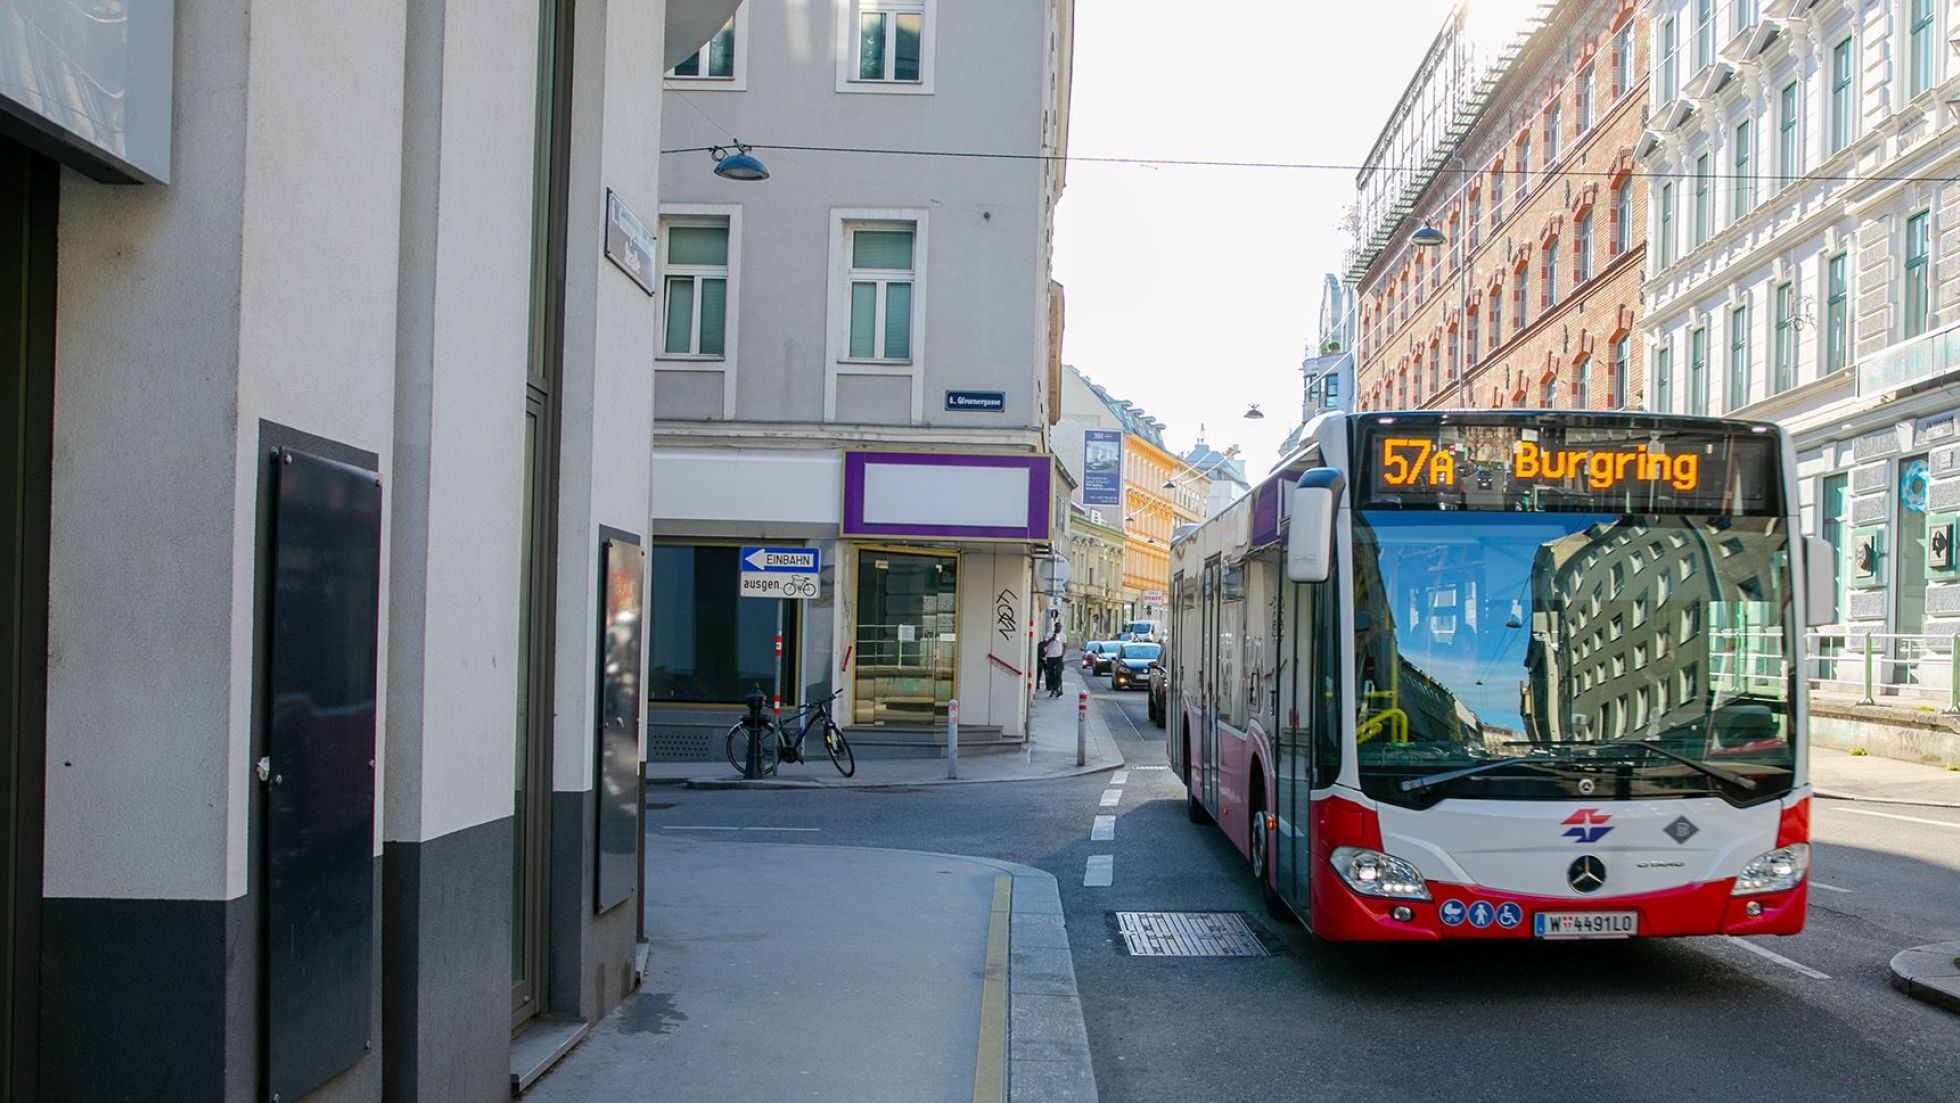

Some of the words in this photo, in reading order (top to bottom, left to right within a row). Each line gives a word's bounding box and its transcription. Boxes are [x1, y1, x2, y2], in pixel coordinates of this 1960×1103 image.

[1383, 438, 1454, 486] 57A
[1515, 441, 1699, 491] Burgring
[766, 554, 810, 566] EINBAHN
